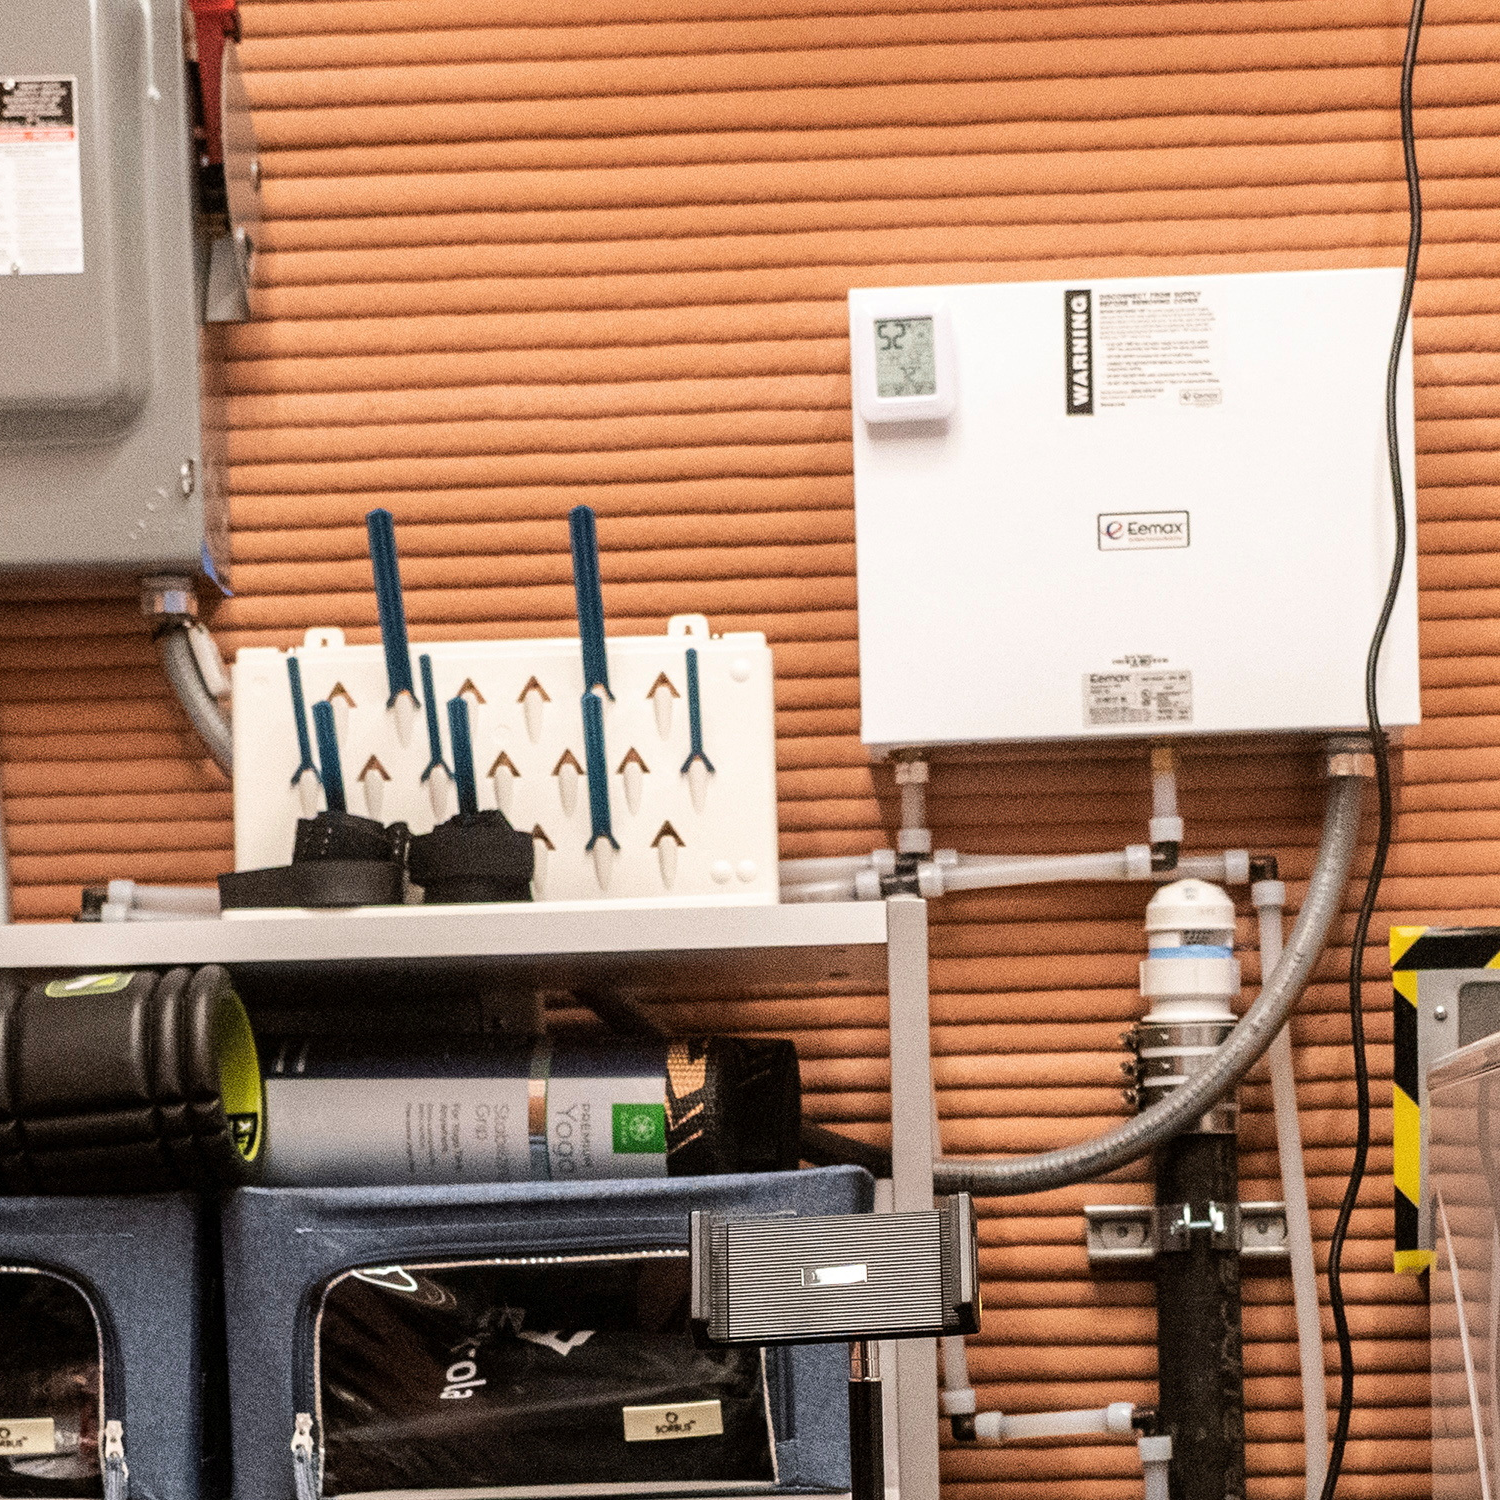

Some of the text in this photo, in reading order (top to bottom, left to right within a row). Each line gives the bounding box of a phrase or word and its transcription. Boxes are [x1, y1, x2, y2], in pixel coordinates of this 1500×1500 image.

[1070, 294, 1090, 406] WARNING
[1127, 521, 1183, 535] Eemax
[553, 1104, 578, 1174] Yoga
[581, 1103, 591, 1168] PREMIUM
